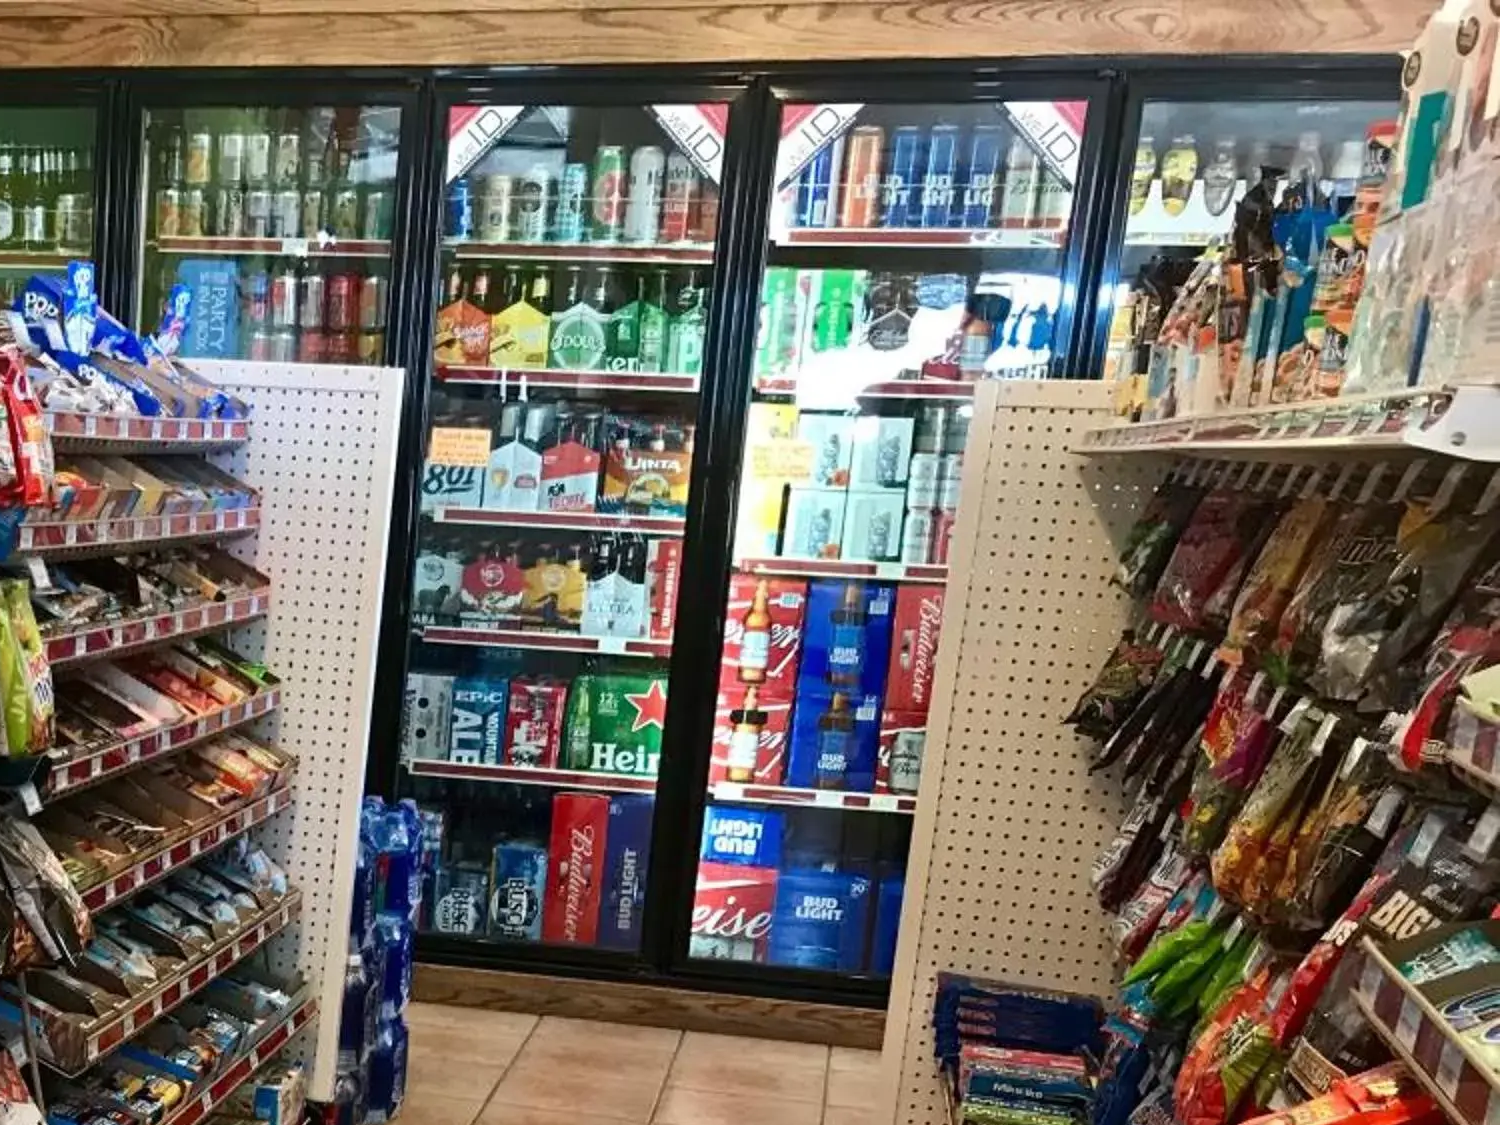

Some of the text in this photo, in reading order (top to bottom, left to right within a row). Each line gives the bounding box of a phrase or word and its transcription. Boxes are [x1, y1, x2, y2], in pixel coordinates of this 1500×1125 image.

[211, 286, 229, 352] PARTY
[624, 456, 683, 472] UINTA
[817, 760, 849, 772] LIGHT
[821, 752, 846, 763] BUD
[710, 818, 764, 838] LIGHT
[713, 837, 757, 856] BUD
[564, 825, 595, 943] Budweiser
[617, 847, 638, 931] BUD LIGHT
[802, 895, 839, 910] BUD
[795, 906, 845, 922] LIGHT
